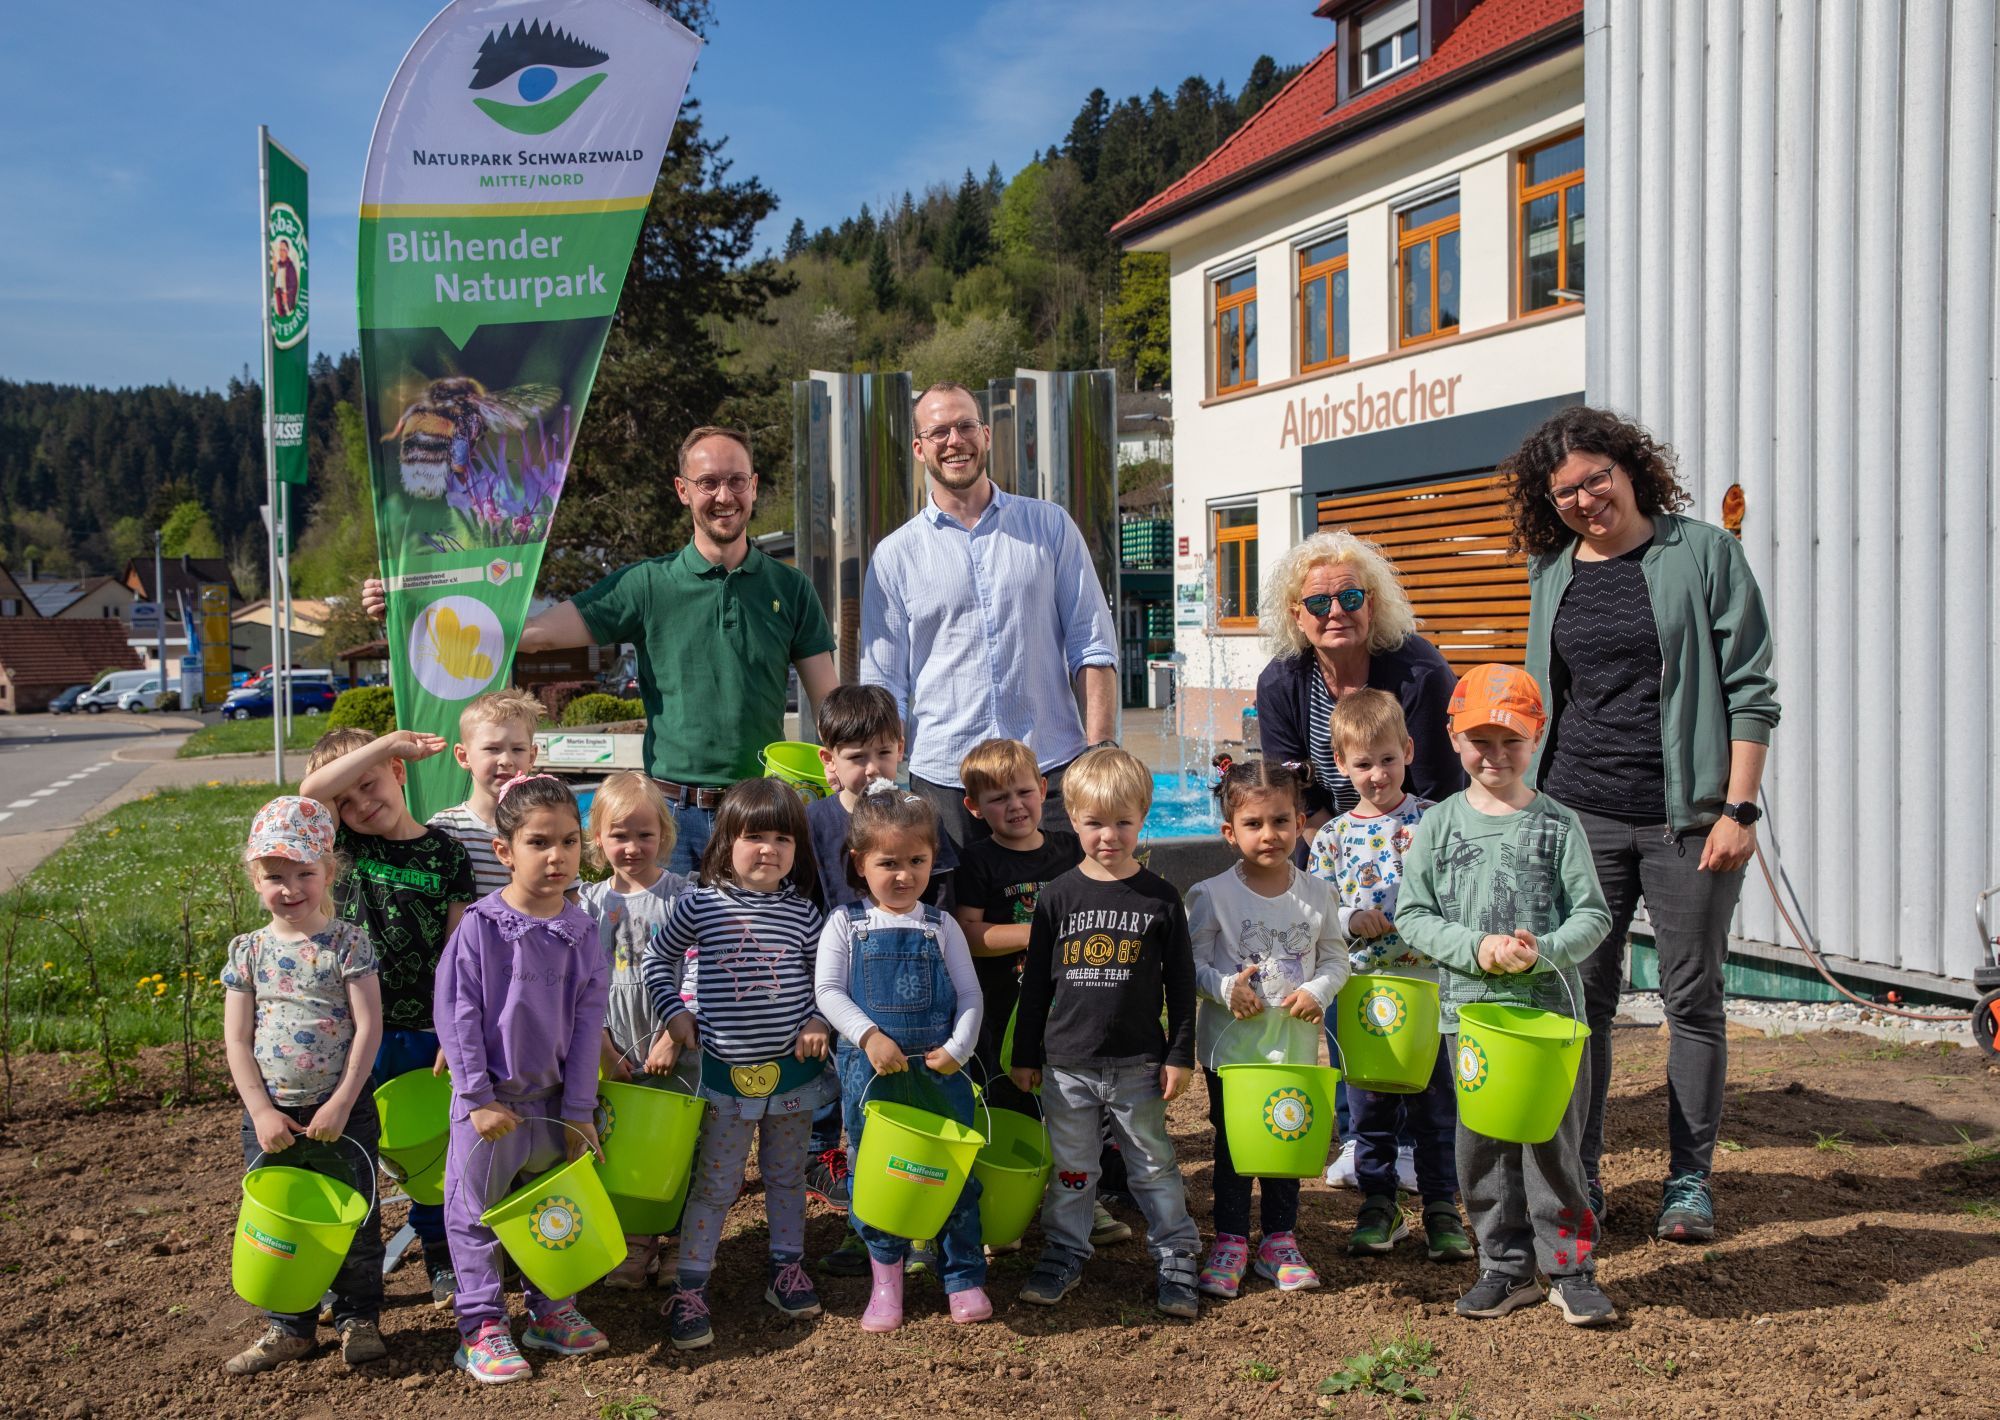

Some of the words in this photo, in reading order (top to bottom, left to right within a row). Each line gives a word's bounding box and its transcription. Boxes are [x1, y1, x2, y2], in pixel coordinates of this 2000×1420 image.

[413, 150, 513, 167] NATURPARK
[518, 148, 644, 166] SCHWARZWALD
[479, 173, 584, 189] MITTE/NORD
[387, 228, 563, 264] Blühender
[435, 264, 608, 308] Naturpark
[1279, 369, 1463, 450] Alpirsbacher
[357, 857, 441, 889] MINECRAFT
[1059, 909, 1154, 939] LEGENDARY
[1062, 939, 1081, 965] 19
[1117, 939, 1141, 963] 83
[1065, 967, 1100, 980] COLLEGE
[1104, 968, 1131, 981] TEAM
[907, 1163, 944, 1177] Raiffeisen
[256, 1231, 292, 1250] Raiffeisen
